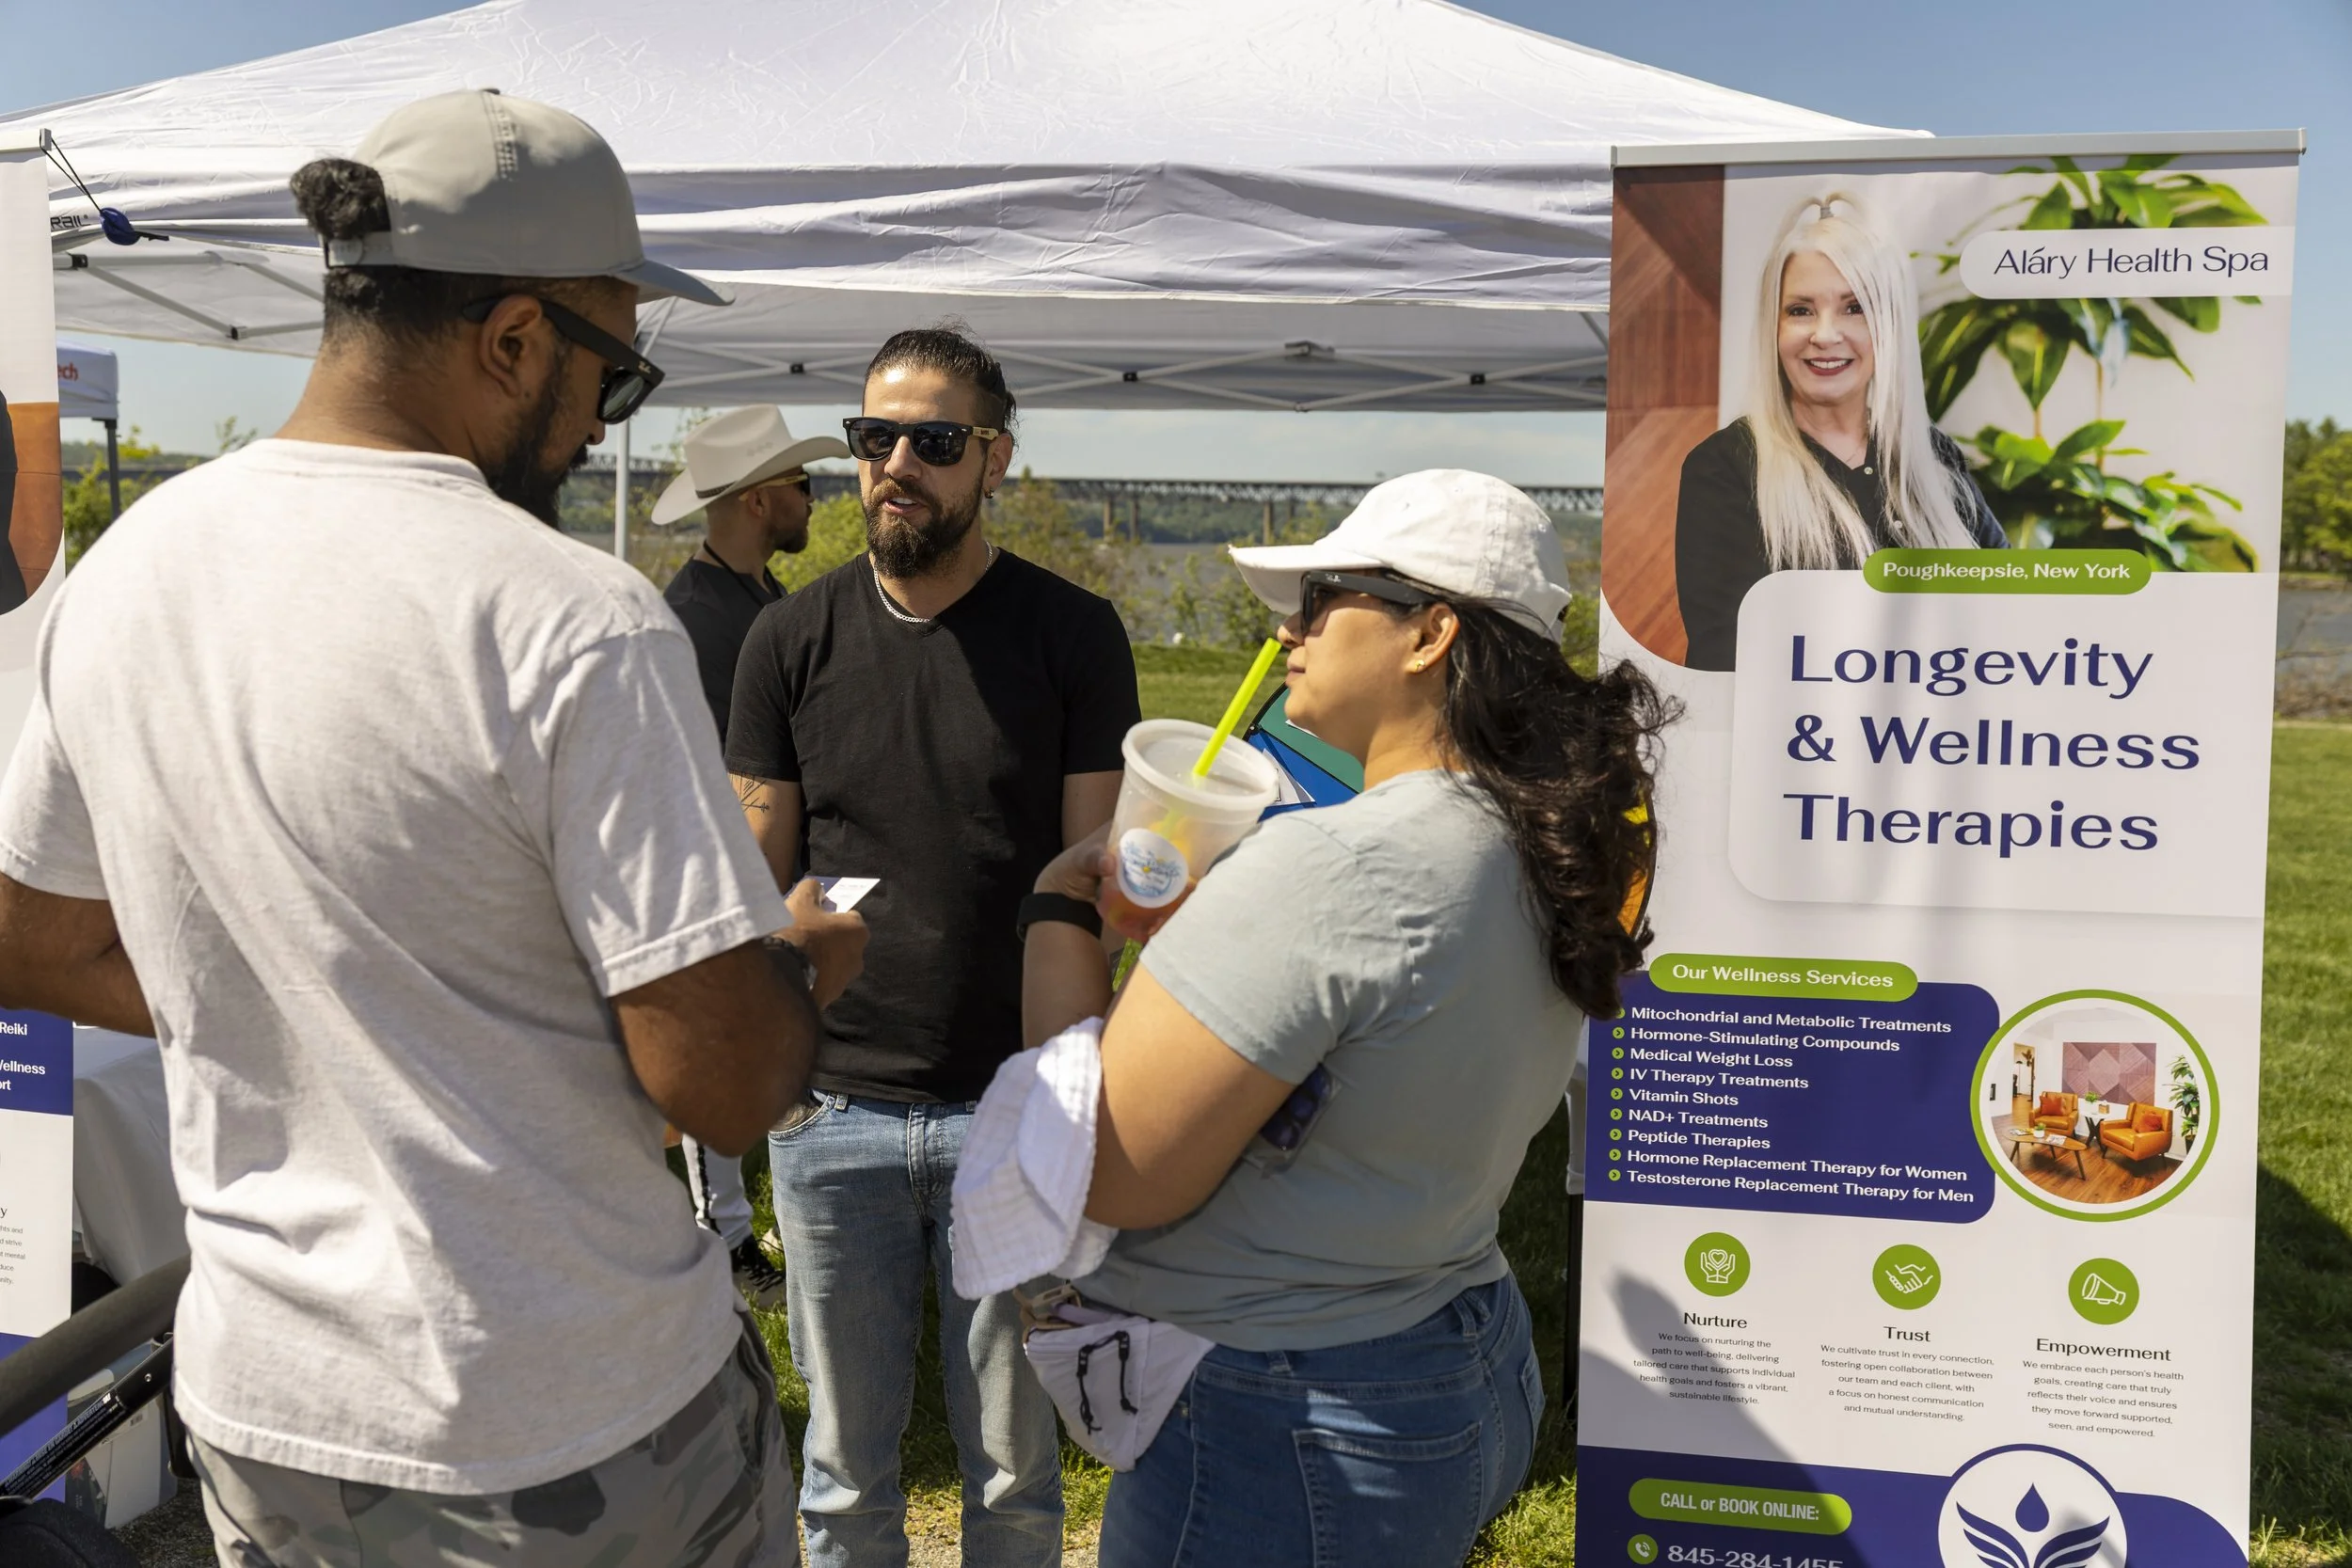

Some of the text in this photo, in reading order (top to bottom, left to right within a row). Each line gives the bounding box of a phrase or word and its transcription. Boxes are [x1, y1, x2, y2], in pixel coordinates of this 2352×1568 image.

[1994, 245, 2268, 279] Aláry Health Spa
[1883, 562, 2131, 581] Poughkeepsie, New York
[1791, 635, 2153, 700] Longevity
[1787, 714, 2200, 770] & Wellness
[1783, 793, 2158, 859] Therapies
[1672, 964, 1894, 988] Our Wellness Services
[0, 1022, 27, 1036] Reiki
[1631, 1006, 1952, 1033] Mitochondrial and Metabolic Treatments
[1630, 1027, 1900, 1052] Hormone-Stimulating Compounds
[0, 1059, 46, 1075] ellness
[1630, 1047, 1793, 1068] Medical Weight Loss
[1630, 1068, 1809, 1089] IV Therapy Treatments
[1629, 1088, 1739, 1106] Vitamin Shots
[1629, 1109, 1769, 1129] NAD+ Treatments
[1628, 1129, 1771, 1150] Peptide Therapies
[1628, 1149, 1967, 1181] Hormone Replacement Therapy for Women
[1627, 1170, 1974, 1203] Testosterone Replacement Therapy for Men
[1684, 1312, 1748, 1329] Nurture
[1658, 1332, 1673, 1341] We
[1675, 1334, 1700, 1343] focus
[1714, 1338, 1755, 1349] nurturing
[1883, 1325, 1931, 1342] Trust
[1651, 1347, 1672, 1355] path
[1735, 1353, 1780, 1365] delivering
[1820, 1344, 1836, 1353] We
[1836, 1346, 1877, 1356] cultivate
[1878, 1349, 1899, 1358] trust
[1912, 1353, 1938, 1362] every
[2036, 1338, 2171, 1362] Empowerment
[1633, 1359, 1667, 1370] tailored
[1691, 1363, 1708, 1372] that
[1709, 1366, 1751, 1375] supports
[1752, 1368, 1796, 1378] individual
[1821, 1358, 1994, 1379] fostering open collaboration between
[2022, 1360, 2039, 1370] We
[2040, 1363, 2083, 1372] embrace
[2084, 1366, 2108, 1374] each
[2153, 1370, 2185, 1381] health
[1639, 1373, 1668, 1383] health
[1668, 1377, 1694, 1386] goals
[1714, 1379, 1746, 1389] fosters
[1855, 1376, 1879, 1385] team
[1880, 1378, 1899, 1386] and
[1954, 1384, 1975, 1392] with
[2064, 1379, 2104, 1391] creating
[2105, 1383, 2127, 1391] care
[2129, 1384, 2148, 1393] that
[2150, 1386, 2172, 1396] truly
[1669, 1391, 1721, 1402] sustainable
[1836, 1388, 1862, 1399] focus
[1877, 1392, 1910, 1402] honest
[1911, 1396, 1984, 1408] communication
[2027, 1390, 2064, 1401] reflects
[2065, 1393, 2089, 1402] their
[2089, 1396, 2117, 1404] voice
[2138, 1401, 2178, 1410] ensures
[1843, 1404, 1862, 1413] and
[1863, 1406, 1895, 1415] mutual
[2031, 1405, 2053, 1416] they
[2054, 1408, 2081, 1417] move
[2083, 1409, 2120, 1419] forward
[2075, 1424, 2094, 1433] and
[1661, 1492, 1820, 1521] CALL or BOOK ONLINE:
